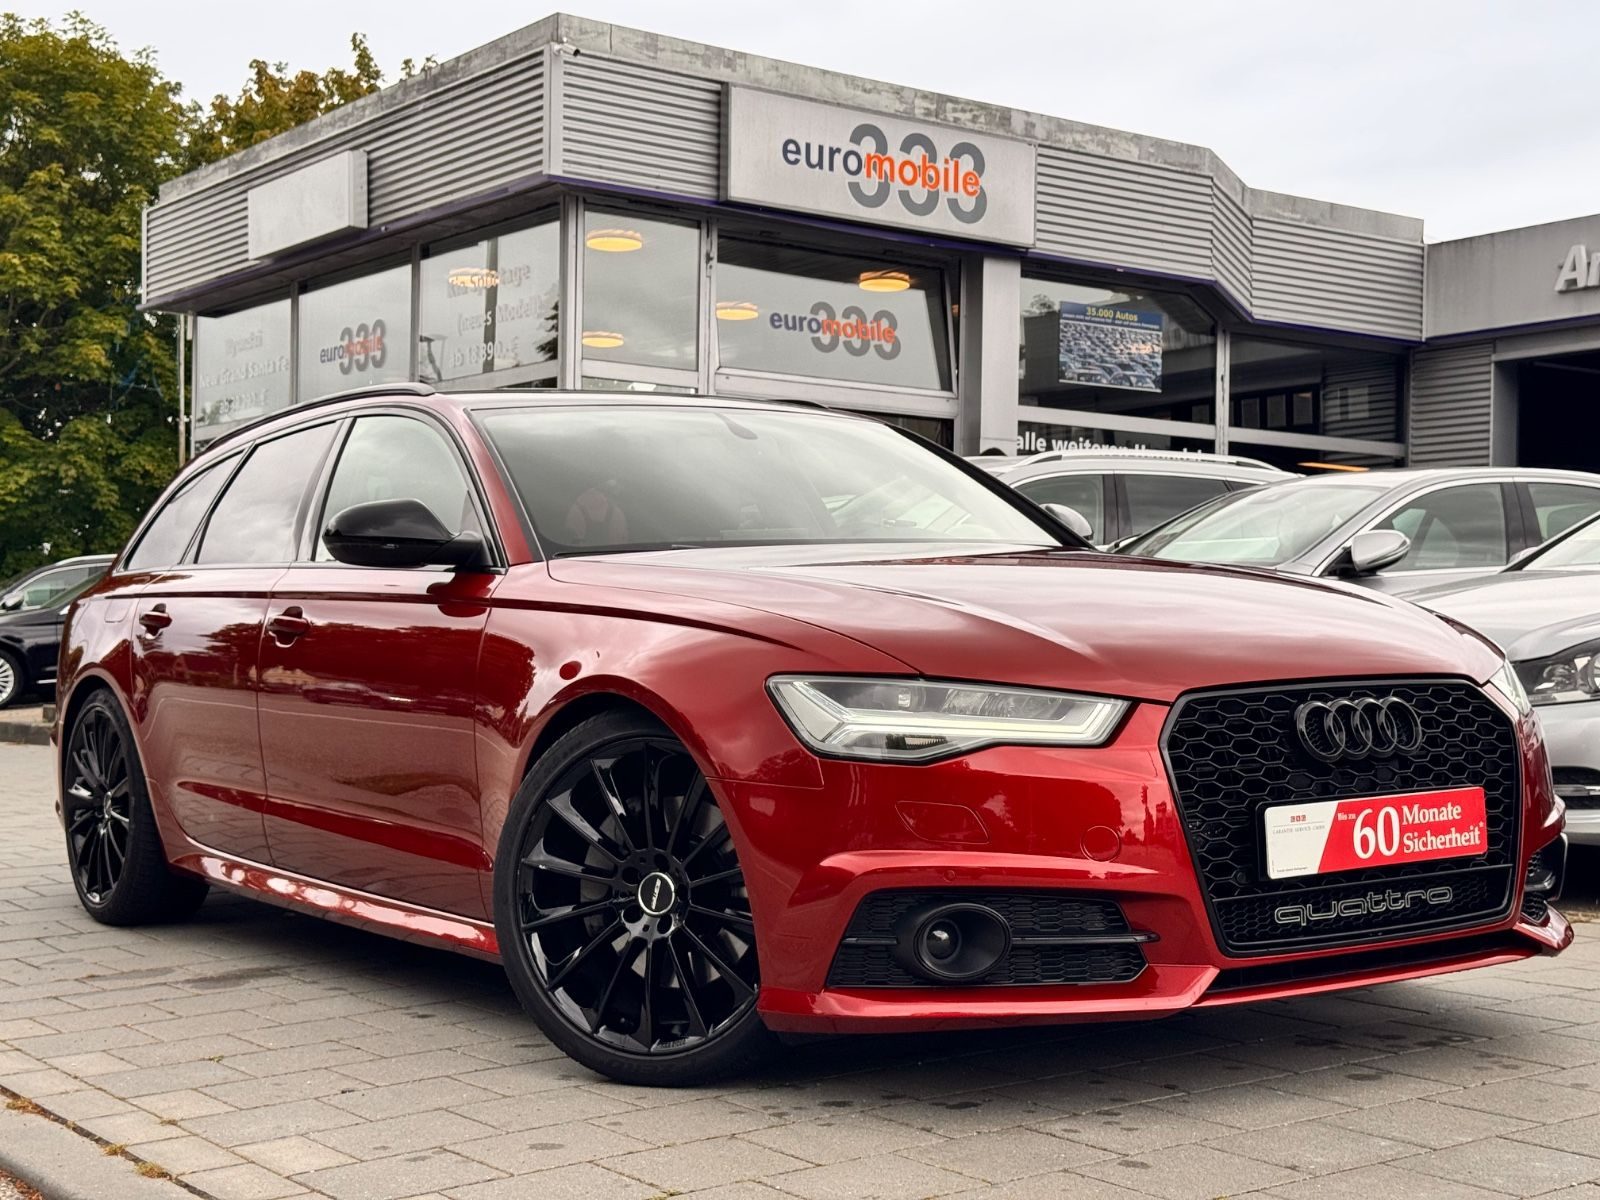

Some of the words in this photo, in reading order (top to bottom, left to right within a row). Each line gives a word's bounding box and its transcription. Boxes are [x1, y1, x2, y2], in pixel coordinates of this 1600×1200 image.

[781, 137, 980, 197] euromobile
[769, 311, 896, 344] euromobile
[1086, 306, 1114, 318] 35.000
[1115, 311, 1138, 322] Autos
[1016, 431, 1047, 452] alle
[1051, 437, 1130, 452] weite
[1353, 806, 1400, 859] 60
[1402, 801, 1462, 825] Monate
[1275, 886, 1453, 926] quattro
